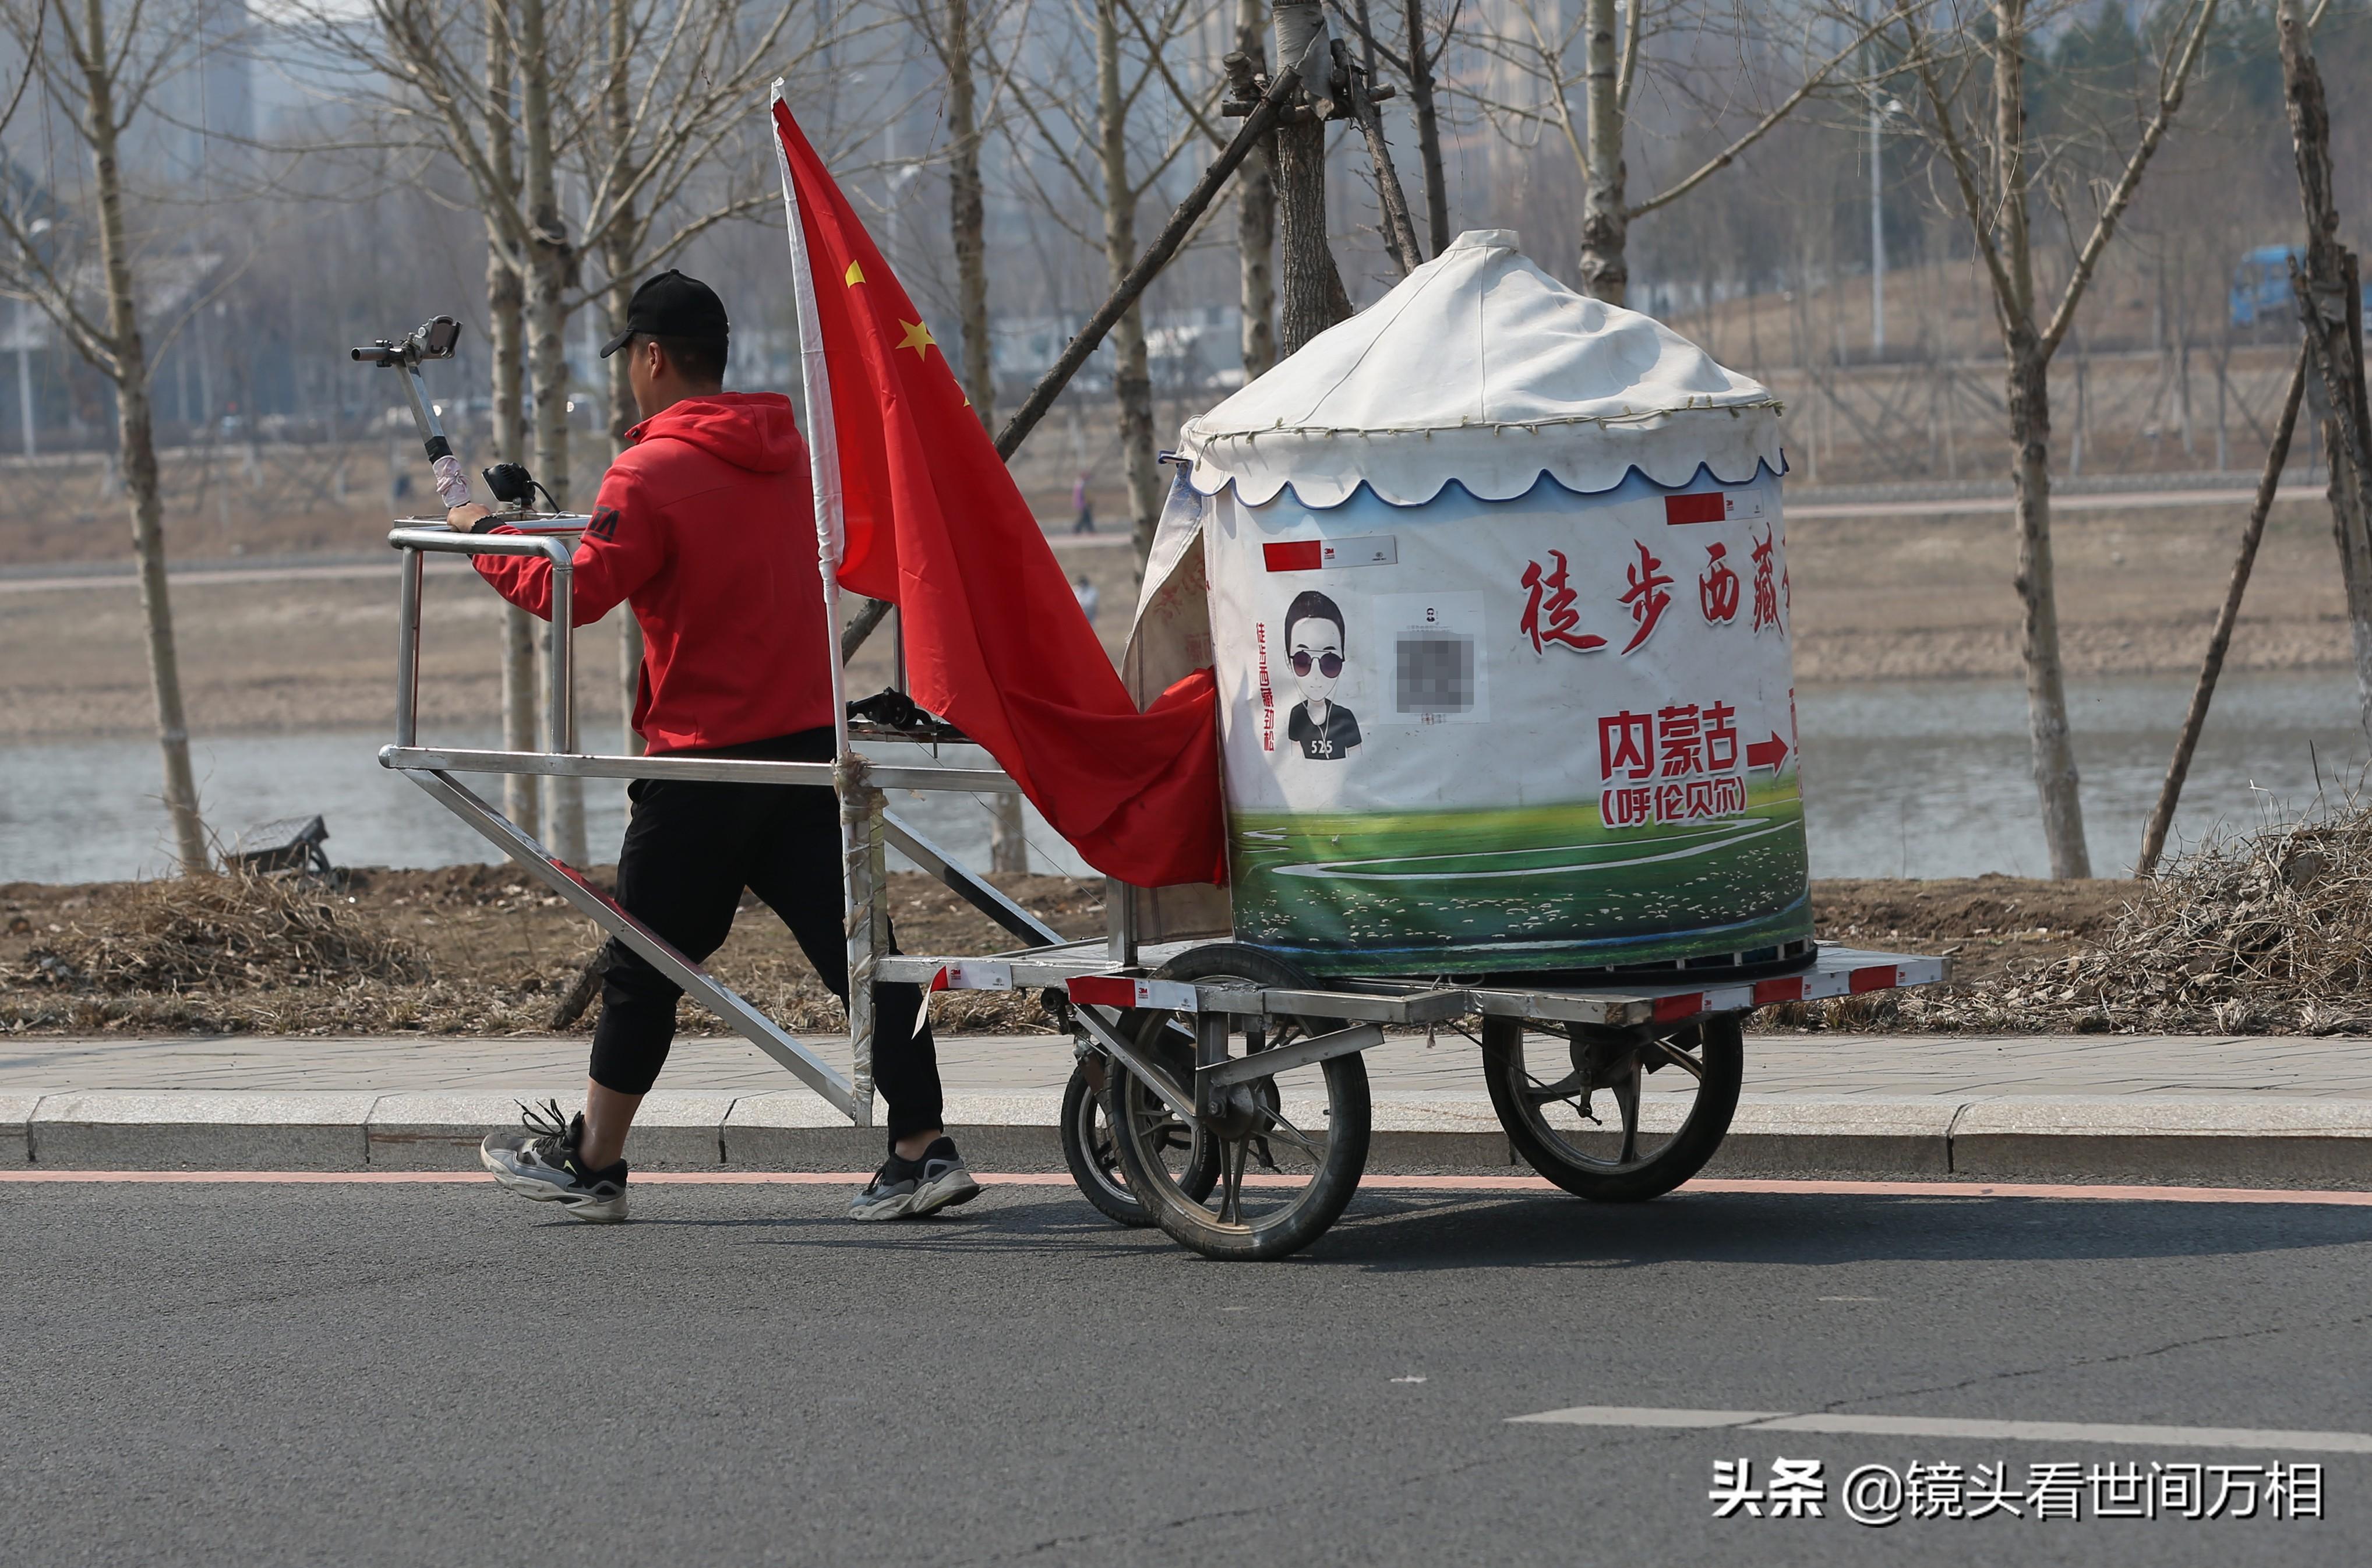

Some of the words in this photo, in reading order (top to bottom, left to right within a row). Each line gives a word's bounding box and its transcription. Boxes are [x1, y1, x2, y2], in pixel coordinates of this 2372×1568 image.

[1256, 622, 1274, 751] 徒步西藏劲松
[1311, 740, 1333, 754] 525
[1598, 701, 1738, 781] 内蒙古
[1602, 776, 1746, 825] (呼伦贝尔)
